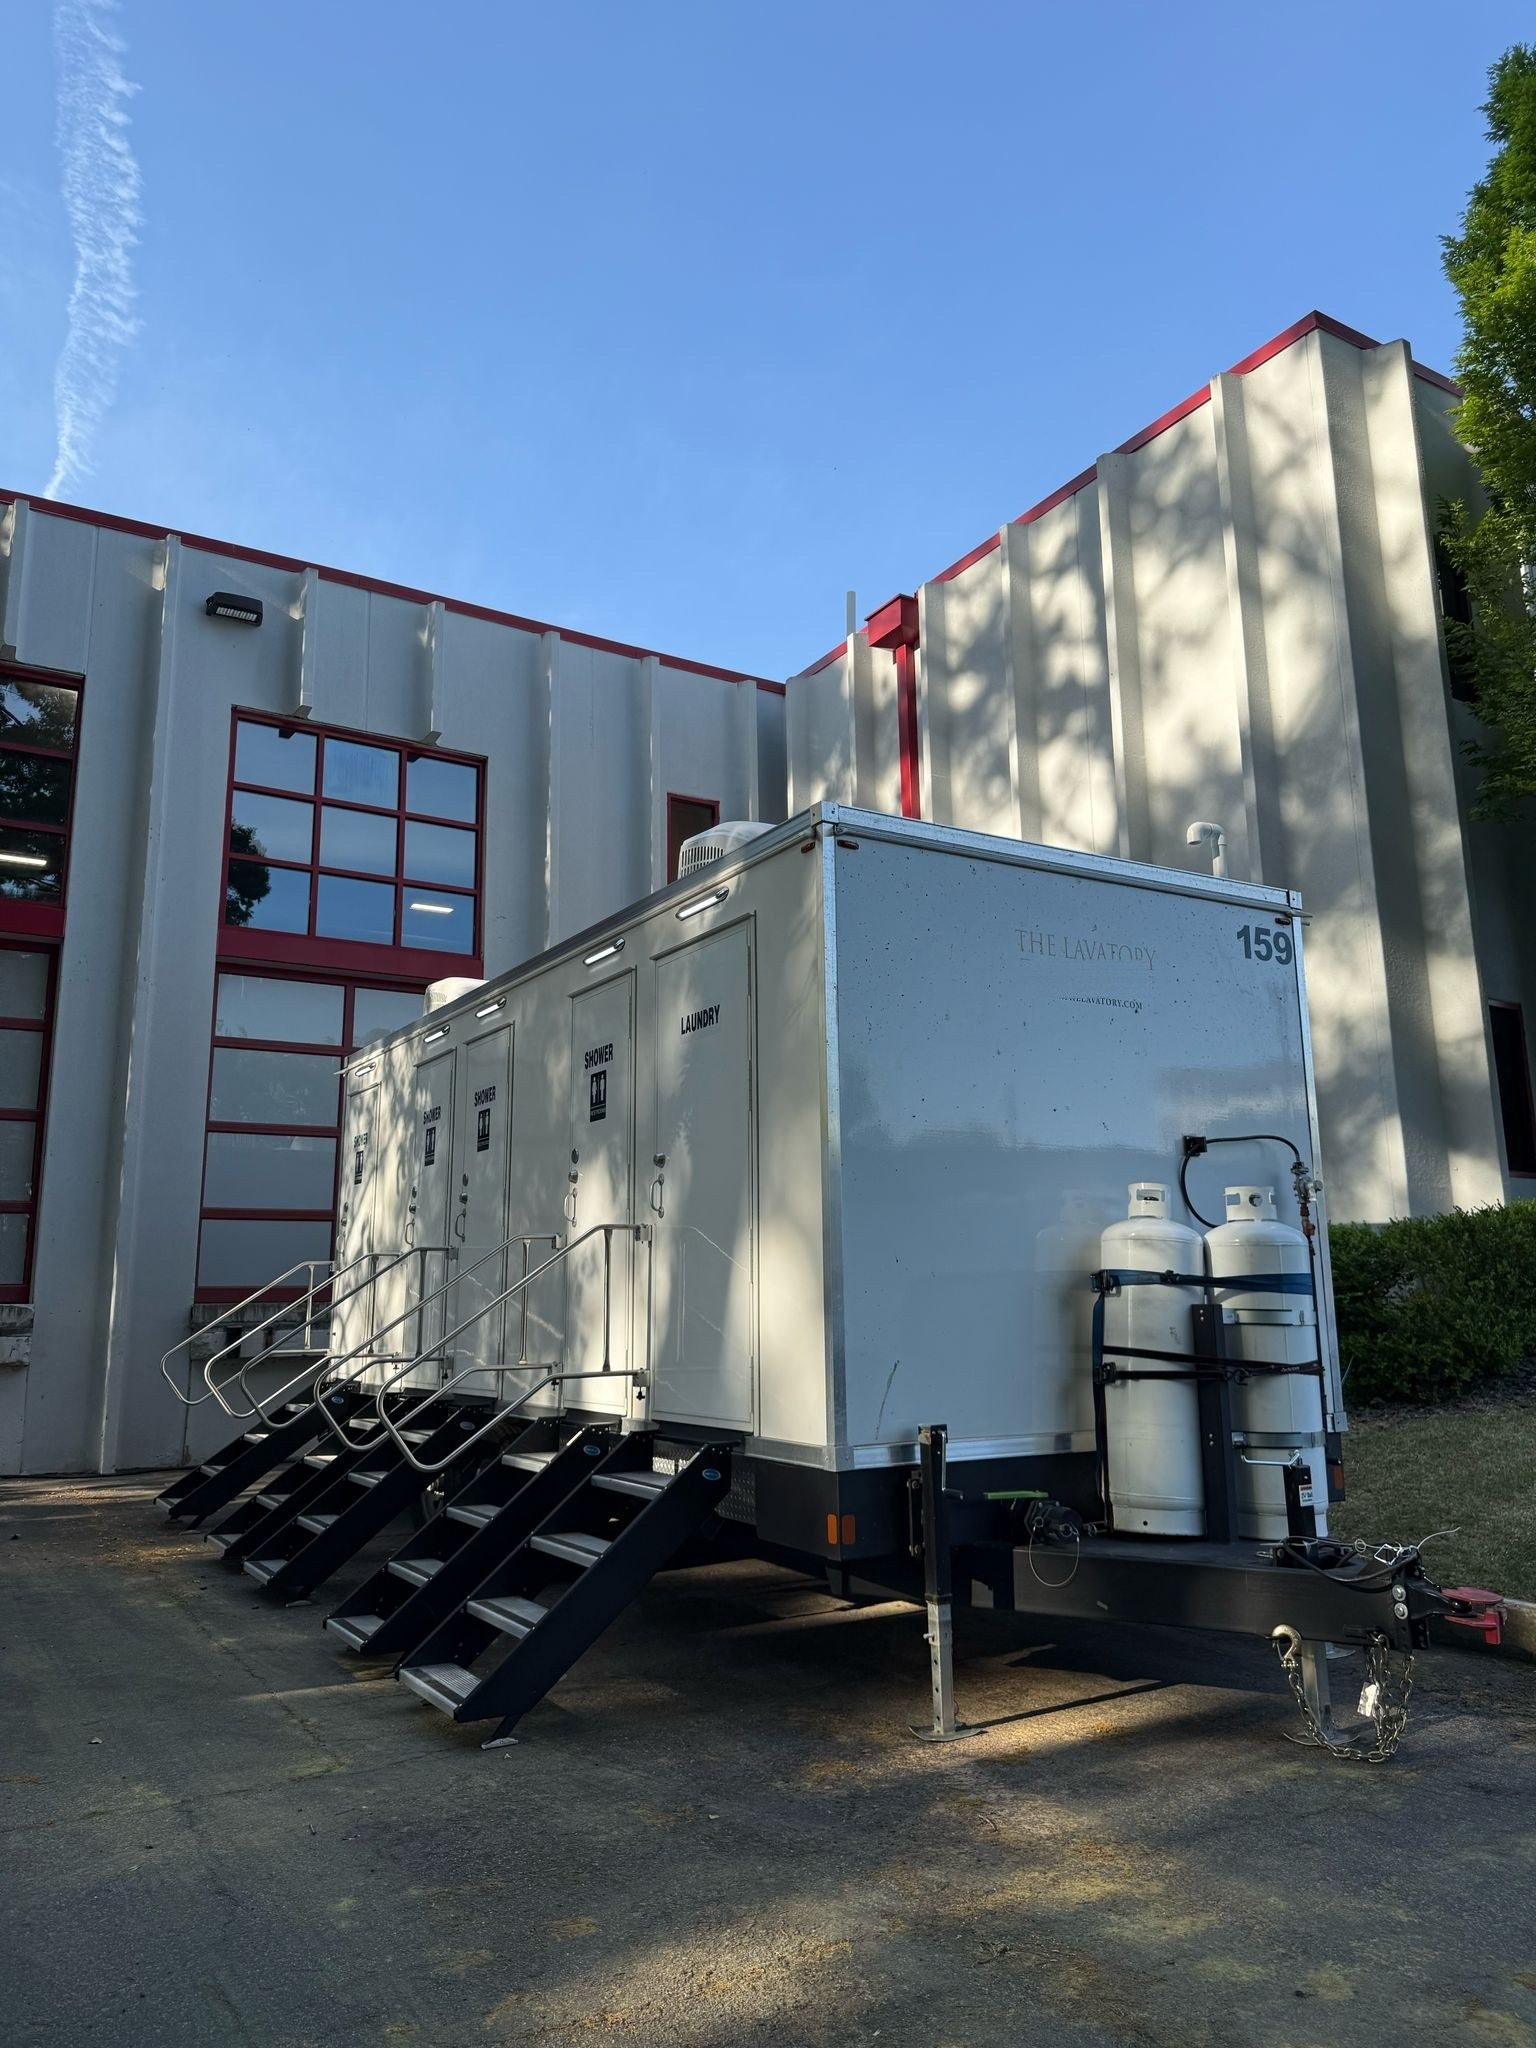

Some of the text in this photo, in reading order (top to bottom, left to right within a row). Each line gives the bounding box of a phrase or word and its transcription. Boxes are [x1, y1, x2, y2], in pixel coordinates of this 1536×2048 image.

[1014, 929, 1157, 970] THE LAVATORY
[1236, 925, 1292, 965] 159
[681, 1004, 720, 1035] LAUNDRY
[584, 1043, 613, 1069] SHOWER
[474, 1085, 496, 1107] SHOWER
